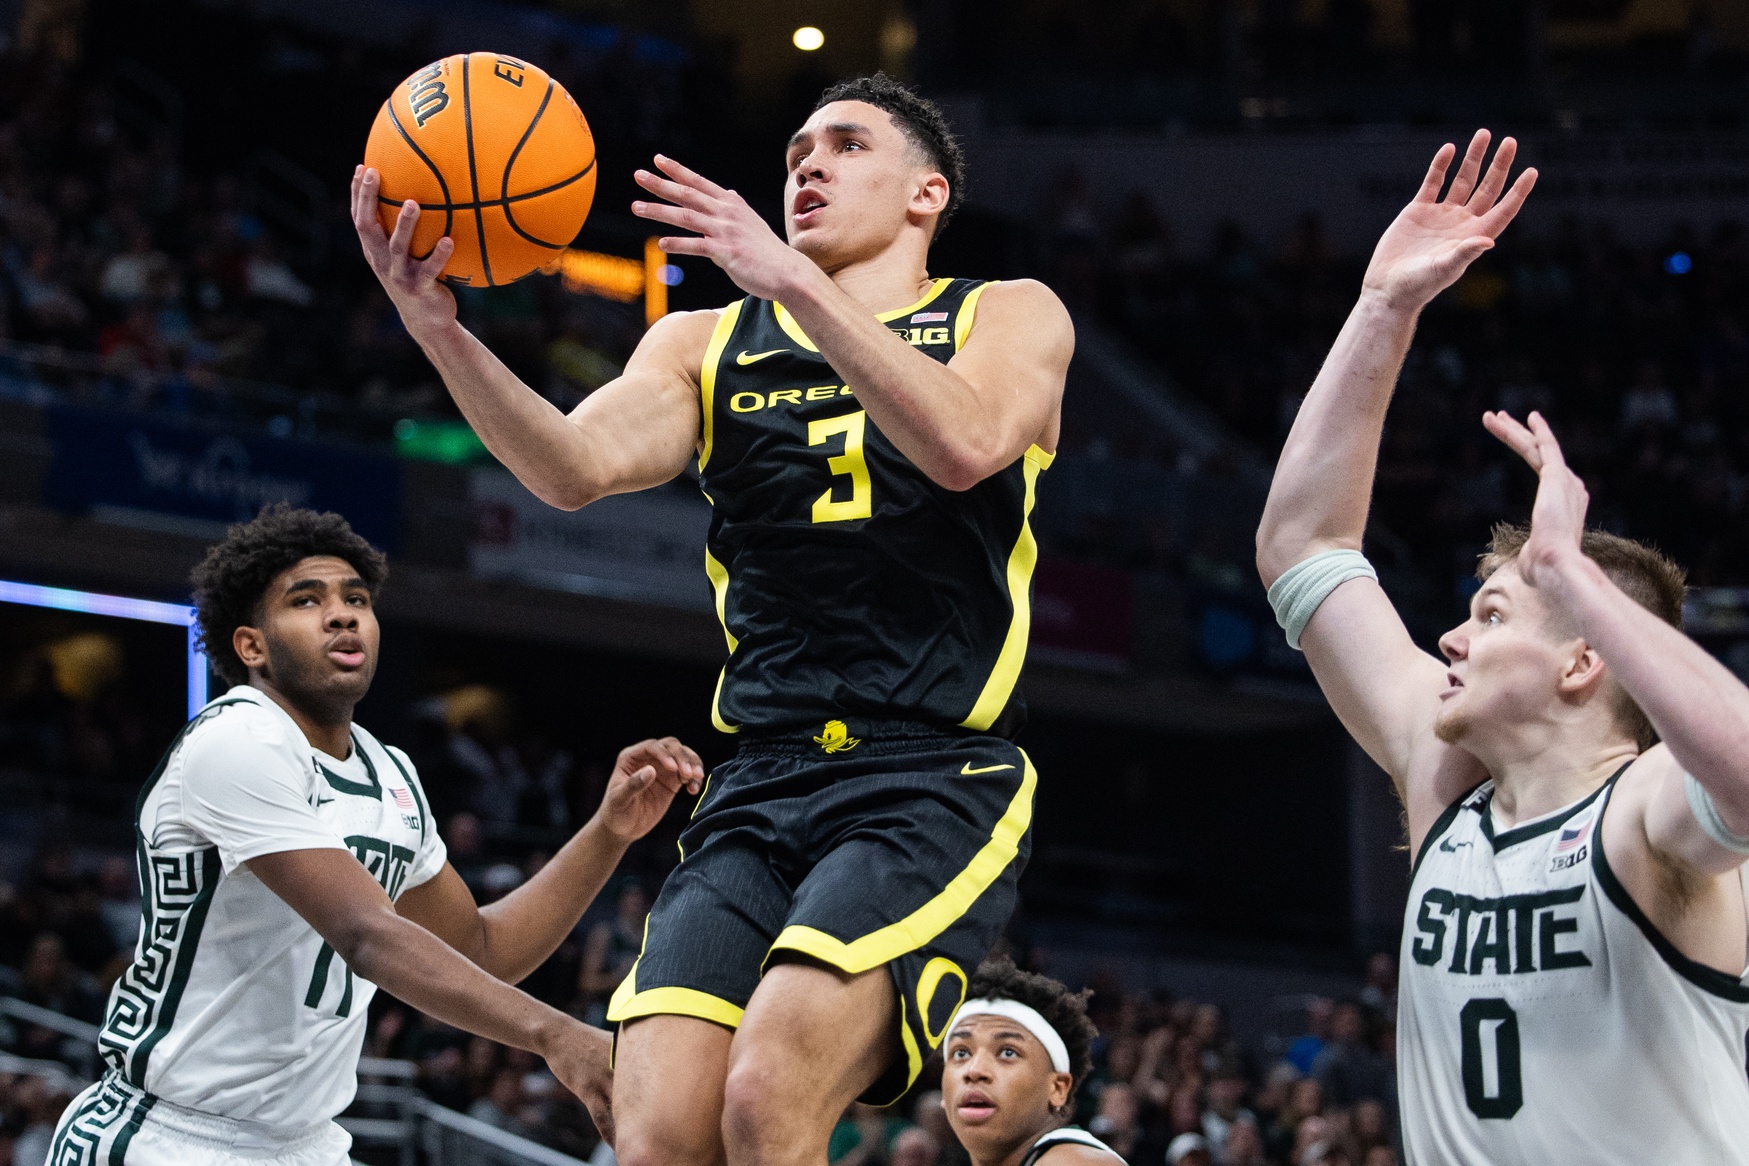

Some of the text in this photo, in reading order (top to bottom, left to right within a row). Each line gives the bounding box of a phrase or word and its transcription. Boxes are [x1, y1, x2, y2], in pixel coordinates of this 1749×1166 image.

[807, 410, 872, 524] 3
[1412, 883, 1593, 976] STATE
[1459, 997, 1524, 1121] 0
